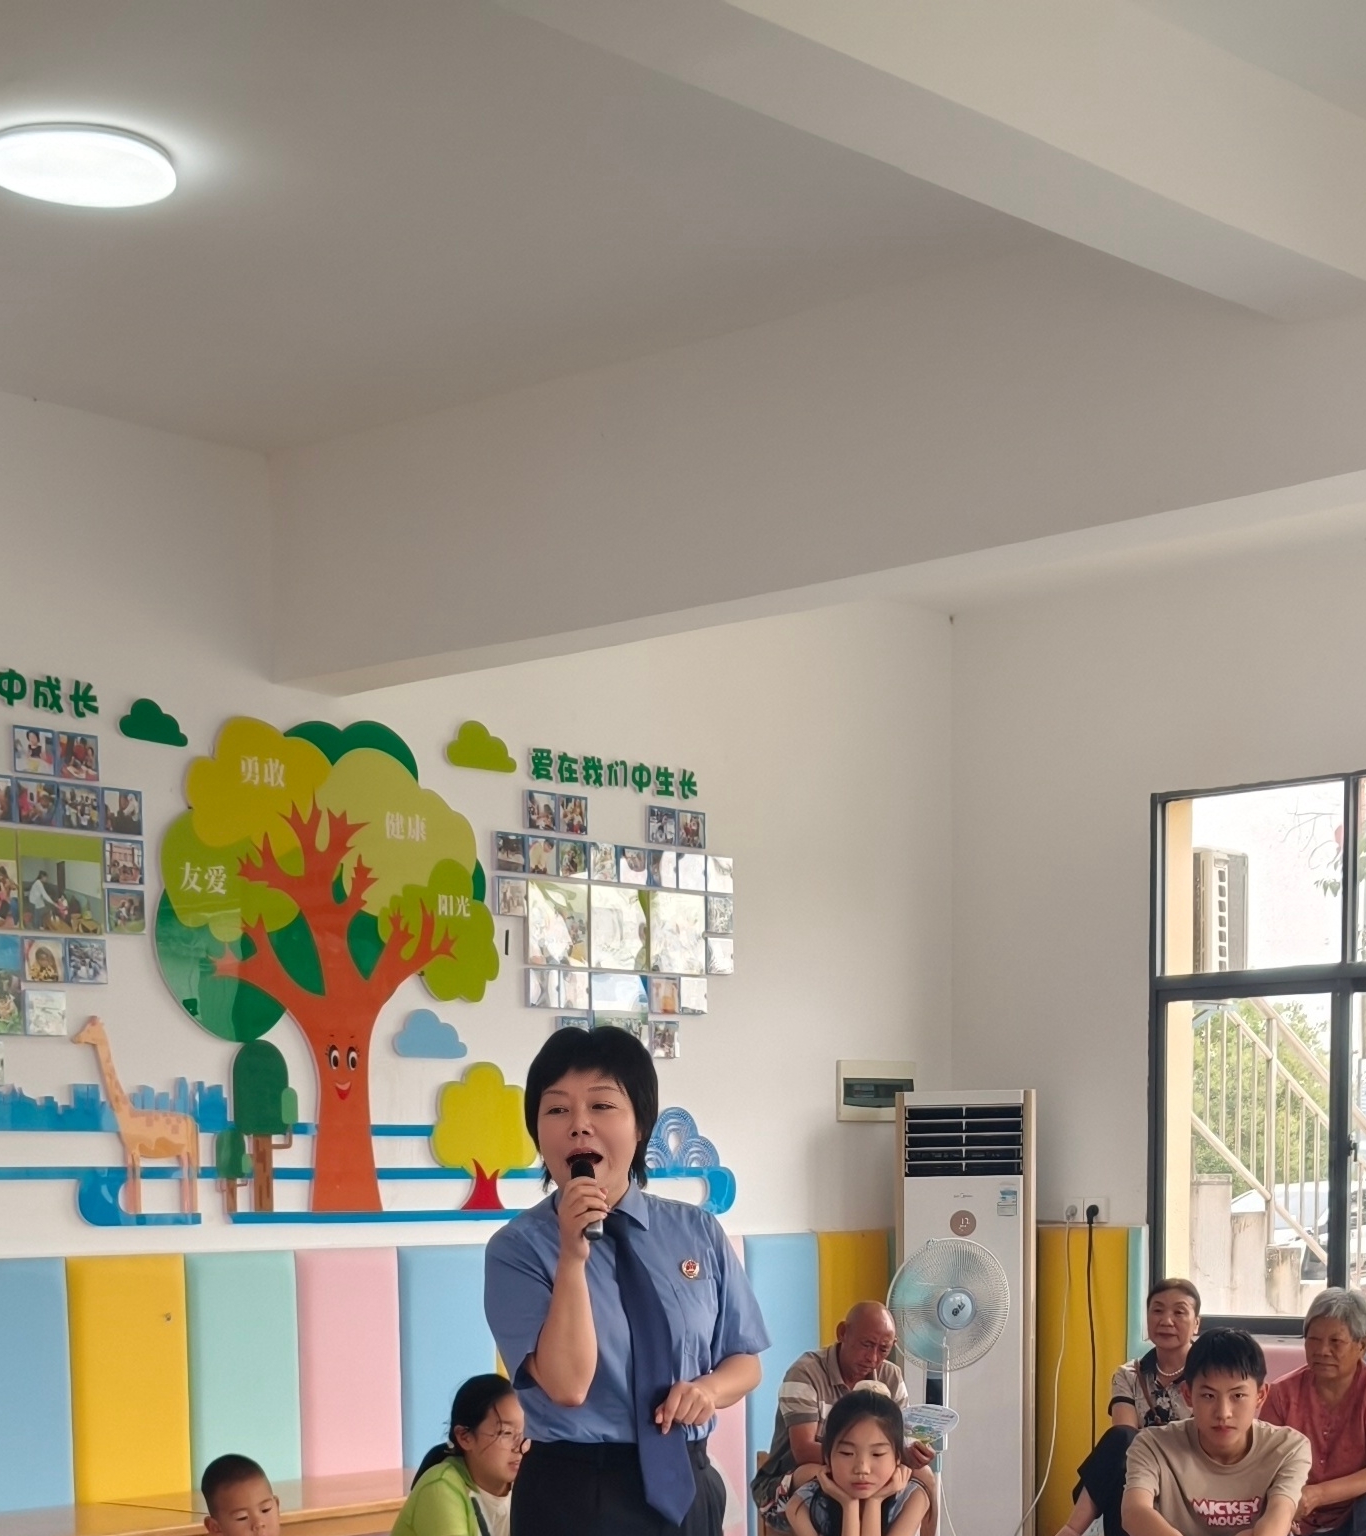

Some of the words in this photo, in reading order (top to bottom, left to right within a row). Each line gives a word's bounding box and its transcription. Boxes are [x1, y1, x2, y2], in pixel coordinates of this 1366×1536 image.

[240, 756, 286, 788] 勇敢
[530, 748, 700, 799] 爱在我们中生长
[385, 811, 428, 843] 健康
[180, 861, 227, 895] 友爱
[438, 894, 472, 919] 阳光
[1192, 1497, 1260, 1516] MICKEY
[1208, 1515, 1251, 1526] MOUSE
